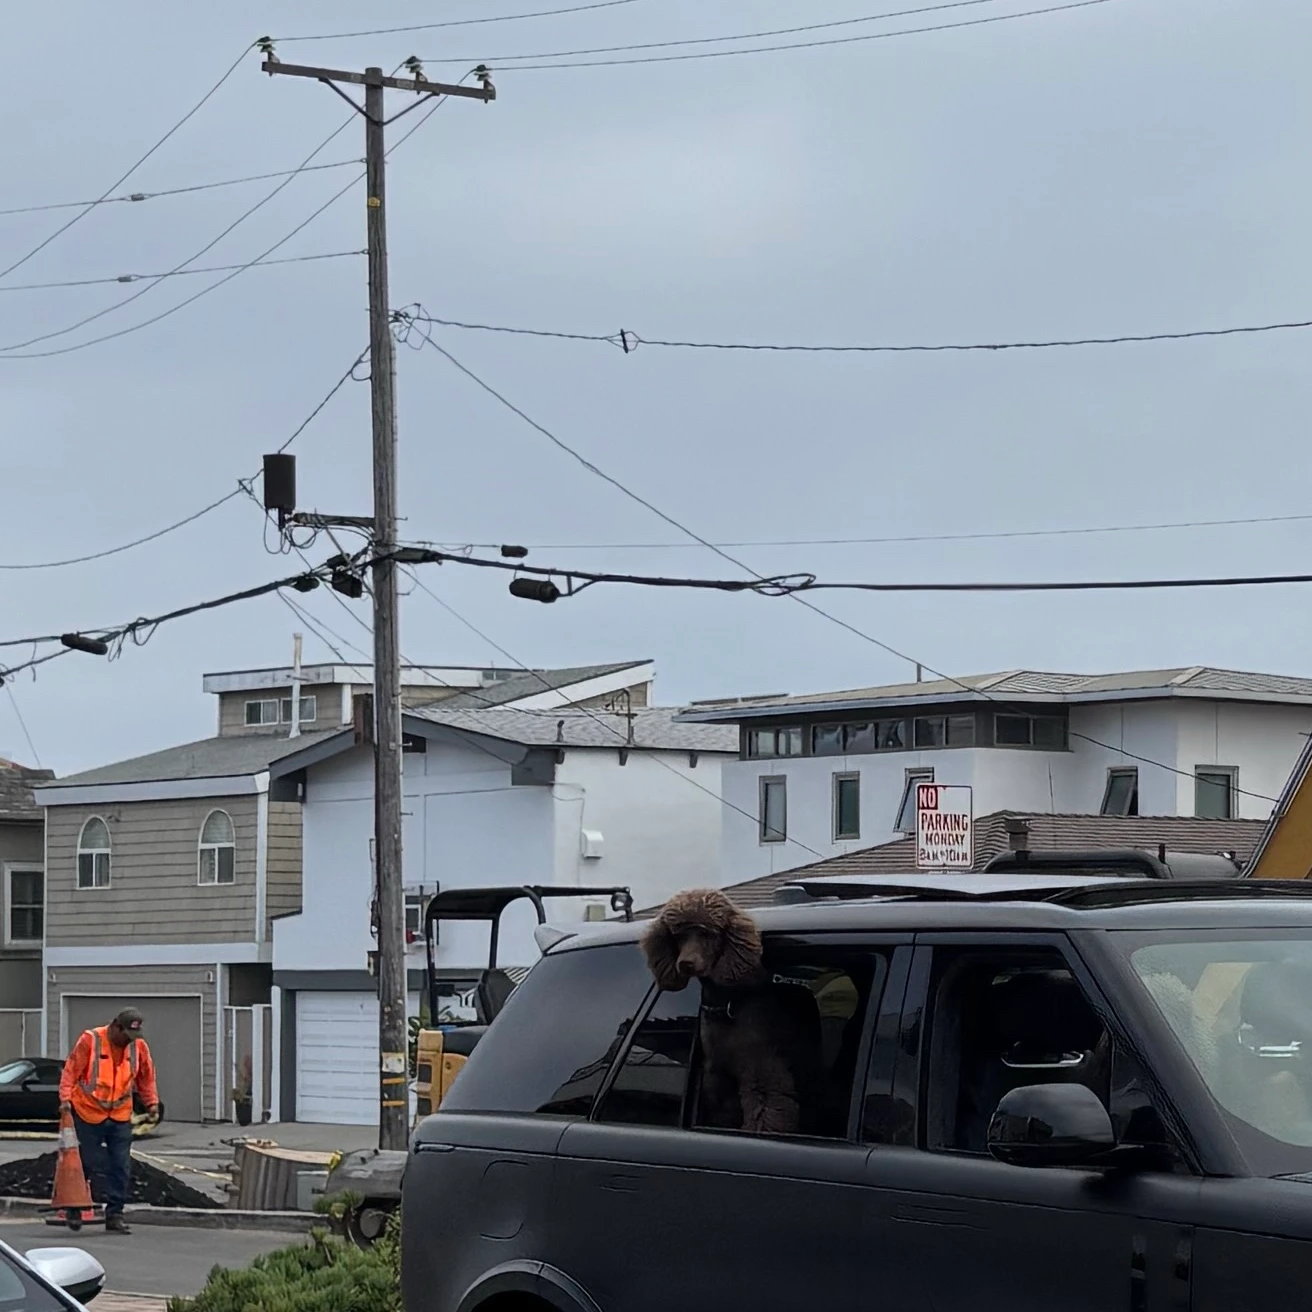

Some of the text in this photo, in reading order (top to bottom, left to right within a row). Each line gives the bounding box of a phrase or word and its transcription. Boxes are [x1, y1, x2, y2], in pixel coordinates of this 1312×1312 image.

[919, 787, 936, 808] NO
[921, 813, 968, 831] PARKING
[925, 833, 965, 846] MONDAY
